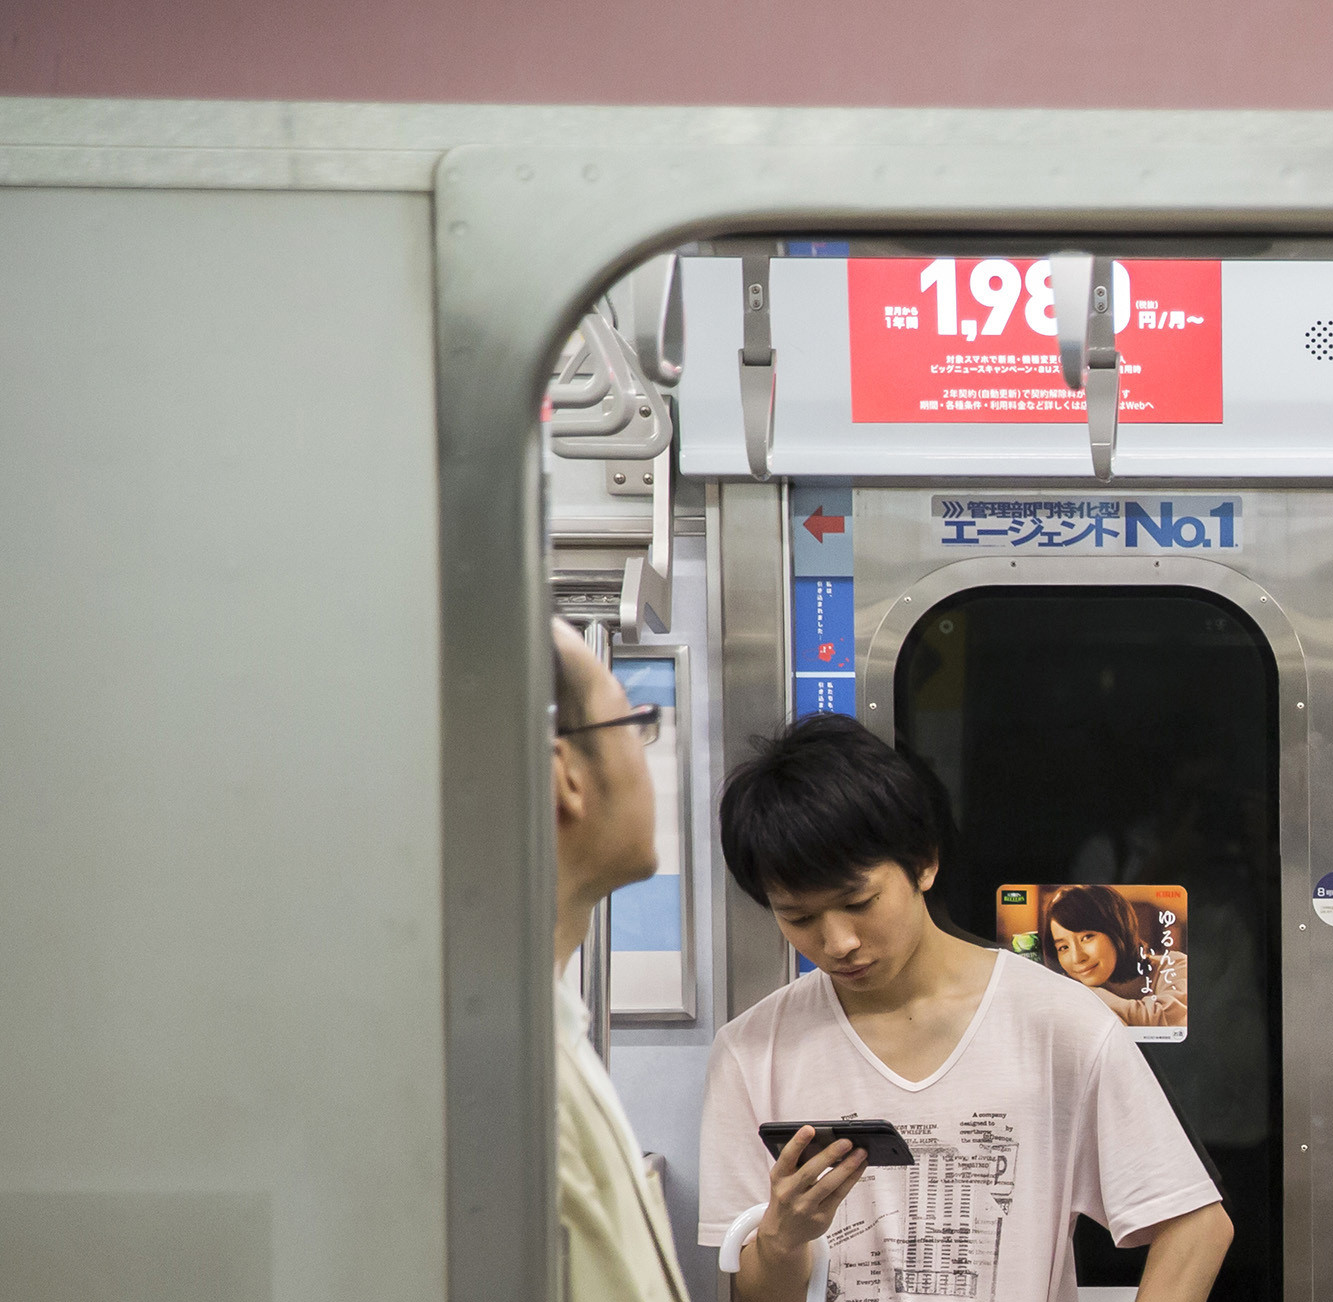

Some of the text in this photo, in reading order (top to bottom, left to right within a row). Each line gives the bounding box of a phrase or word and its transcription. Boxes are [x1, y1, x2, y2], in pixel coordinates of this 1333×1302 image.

[884, 316, 919, 330] 1年間
[967, 501, 1120, 519] 管理部門特化型
[941, 515, 1120, 548] エージェント
[1155, 890, 1182, 899] KIRIN
